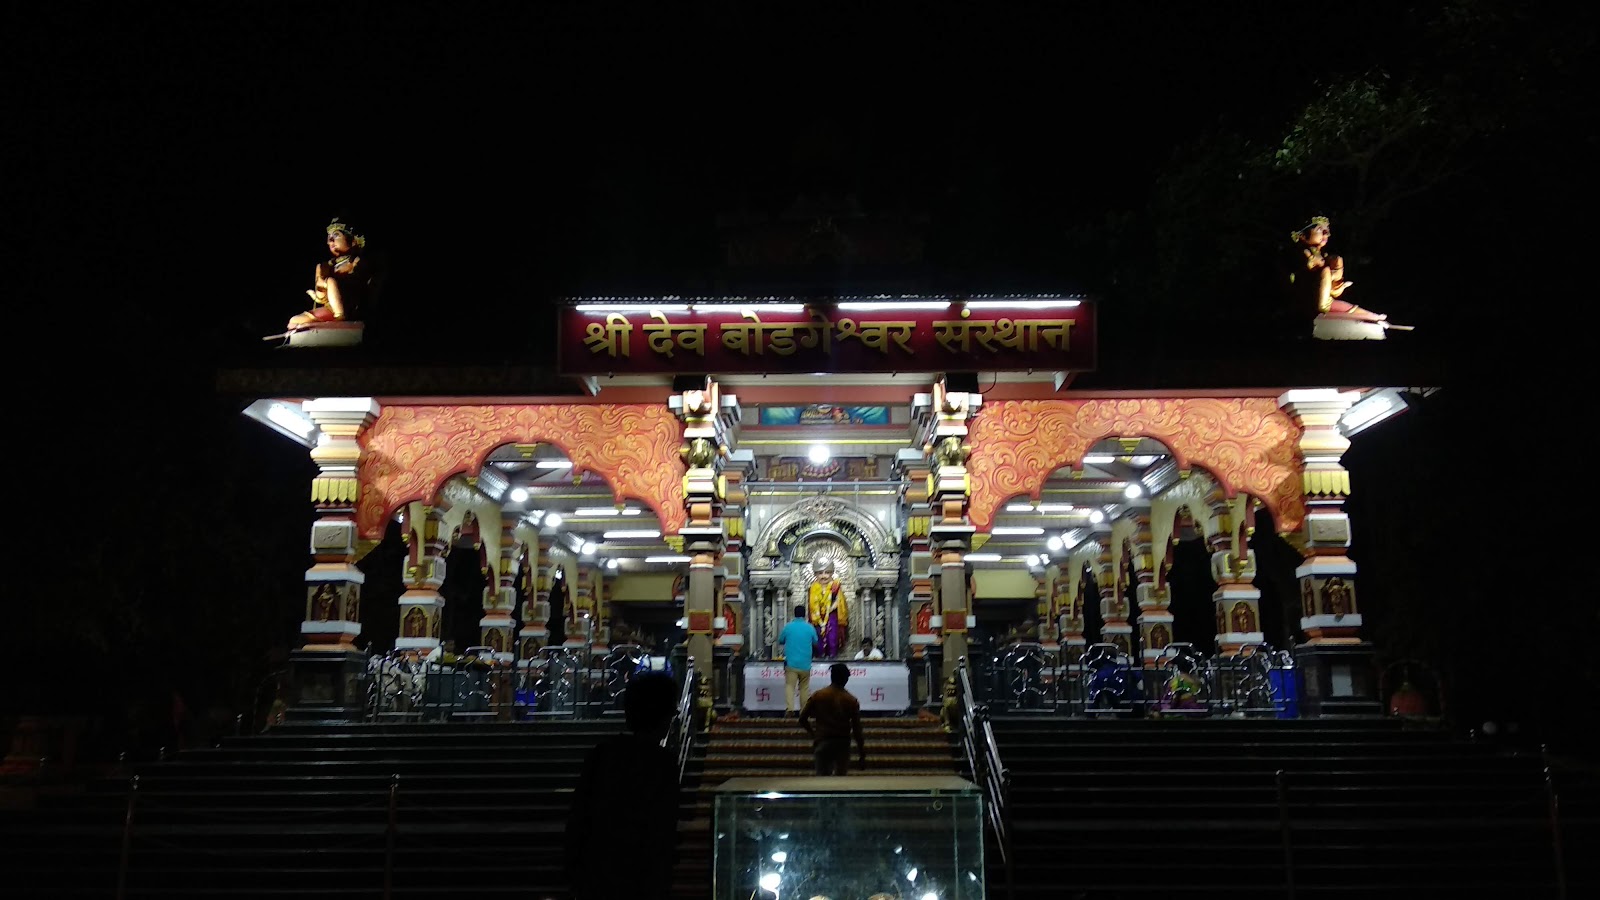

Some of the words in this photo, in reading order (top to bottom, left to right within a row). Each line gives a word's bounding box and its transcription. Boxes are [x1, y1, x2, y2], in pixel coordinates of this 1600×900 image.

[583, 312, 633, 357] श्री
[643, 309, 707, 357] देव
[720, 309, 916, 355] बोडगेश्वर
[932, 308, 1076, 353] संस्थान
